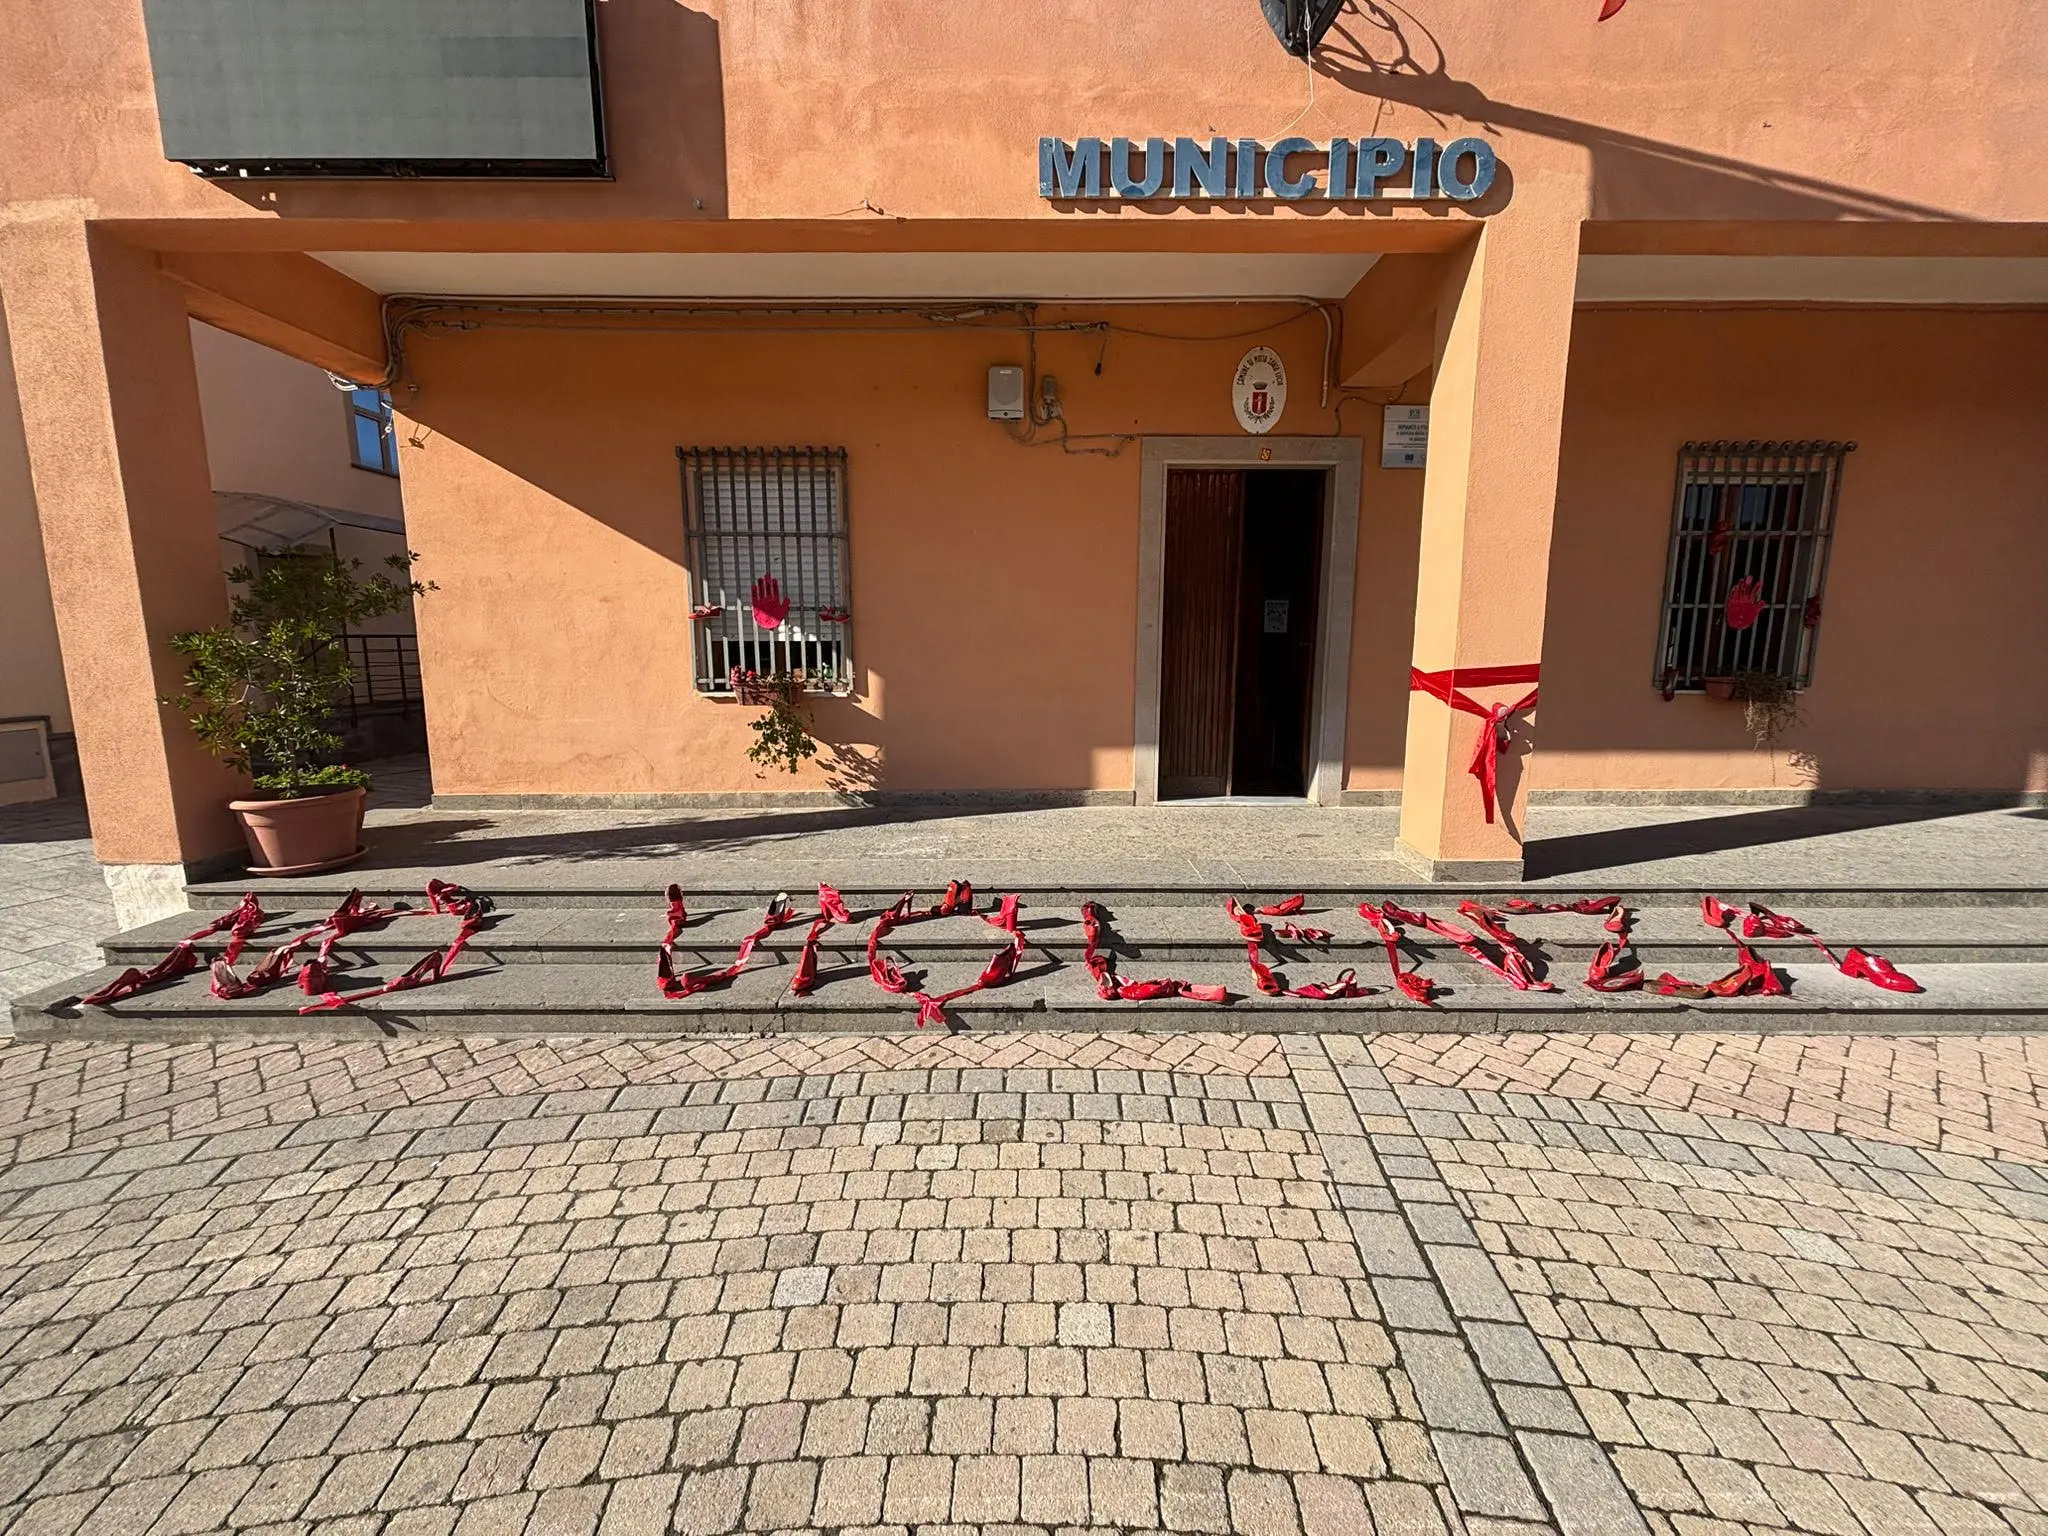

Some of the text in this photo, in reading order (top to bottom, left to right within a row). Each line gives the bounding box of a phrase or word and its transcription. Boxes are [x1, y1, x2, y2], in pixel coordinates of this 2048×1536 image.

[1038, 137, 1497, 200] MUNICIPIO
[1236, 364, 1250, 386] COMUNE
[1267, 357, 1281, 372] SANTA
